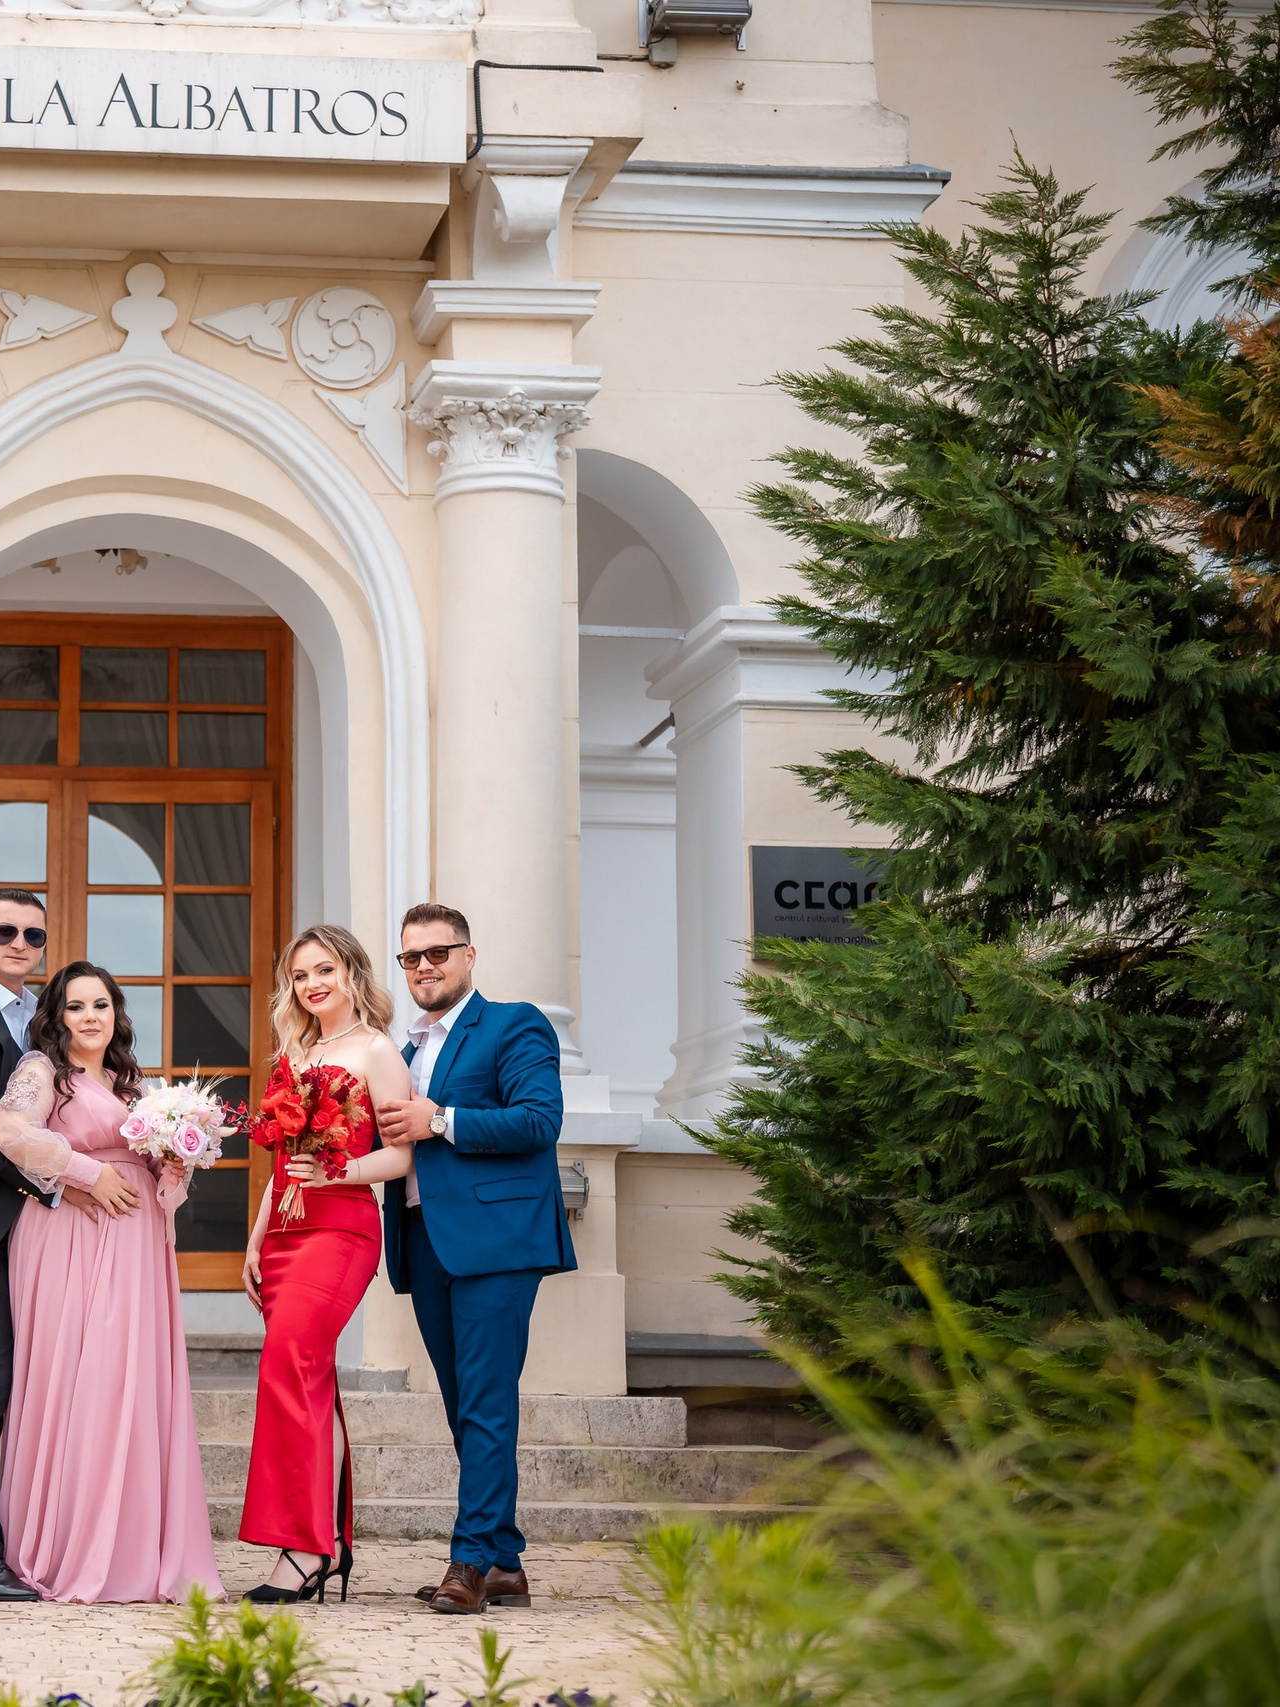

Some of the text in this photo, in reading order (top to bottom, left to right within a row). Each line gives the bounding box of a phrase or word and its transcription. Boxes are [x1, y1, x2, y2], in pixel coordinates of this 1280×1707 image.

[96, 72, 408, 137] ALBATROS
[774, 914, 805, 922] centrul
[806, 914, 840, 923] cultural
